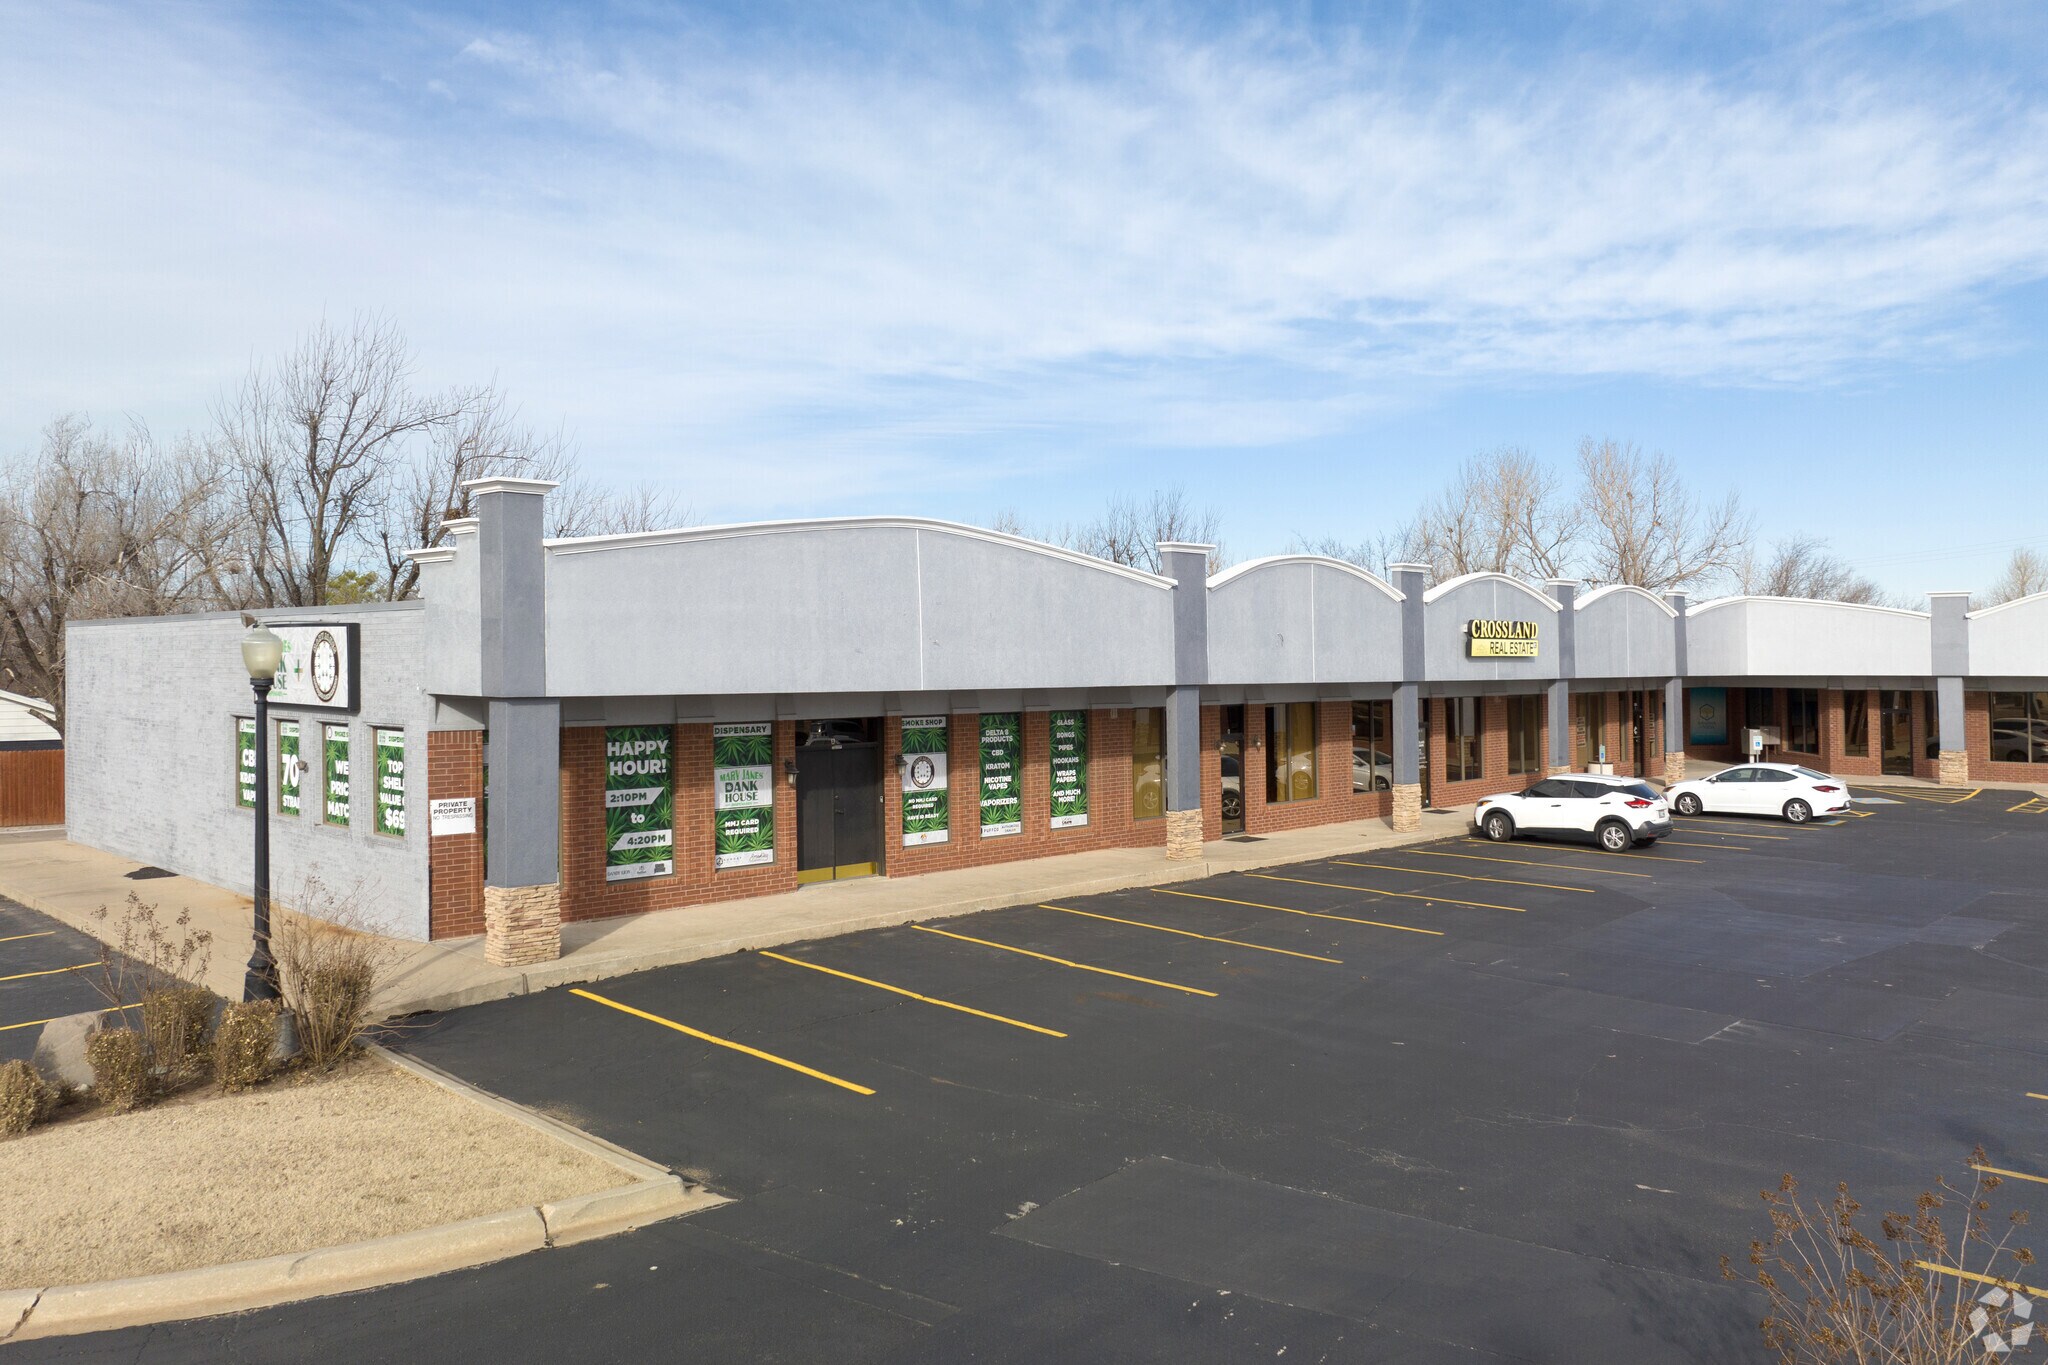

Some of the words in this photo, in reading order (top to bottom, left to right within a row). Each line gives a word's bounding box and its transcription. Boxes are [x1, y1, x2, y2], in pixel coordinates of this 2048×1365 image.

[1472, 619, 1538, 639] CROSSLAND
[1490, 641, 1508, 654] REAL
[1510, 641, 1534, 655] ESTATE
[901, 719, 924, 727] SMOKE
[925, 718, 943, 726] SHOP
[714, 725, 767, 735] DISPENSARY
[986, 729, 1004, 737] DELTA
[1056, 731, 1075, 739] BONGS
[982, 735, 1013, 743] PRODUCTS
[607, 740, 669, 757] HAPPY
[242, 748, 256, 767] CB
[335, 760, 349, 775] WE
[387, 760, 404, 774] TOP
[609, 759, 667, 776] HOUR!
[986, 762, 1010, 770] KRATOM
[720, 769, 740, 782] MARY
[742, 769, 764, 781] JANES
[1056, 769, 1076, 777] WRAPS
[984, 775, 1012, 784] NICOTINE
[330, 780, 349, 796] PRIC
[725, 780, 758, 793] DANK
[988, 782, 1008, 790] VAPES
[610, 792, 647, 803] 2:10PM
[725, 792, 758, 803] HOUSE
[1053, 790, 1065, 798] AND
[1065, 788, 1081, 796] MUCH
[980, 797, 1018, 807] VAPORIZERS
[1058, 795, 1075, 803] MORE!
[327, 801, 349, 818] MATC
[433, 807, 472, 815] PROPERTY
[630, 812, 645, 824] to
[725, 820, 740, 828] MMJ
[740, 819, 759, 827] CARD
[725, 827, 759, 836] REQUIRED
[627, 834, 666, 846] 4:20PM
